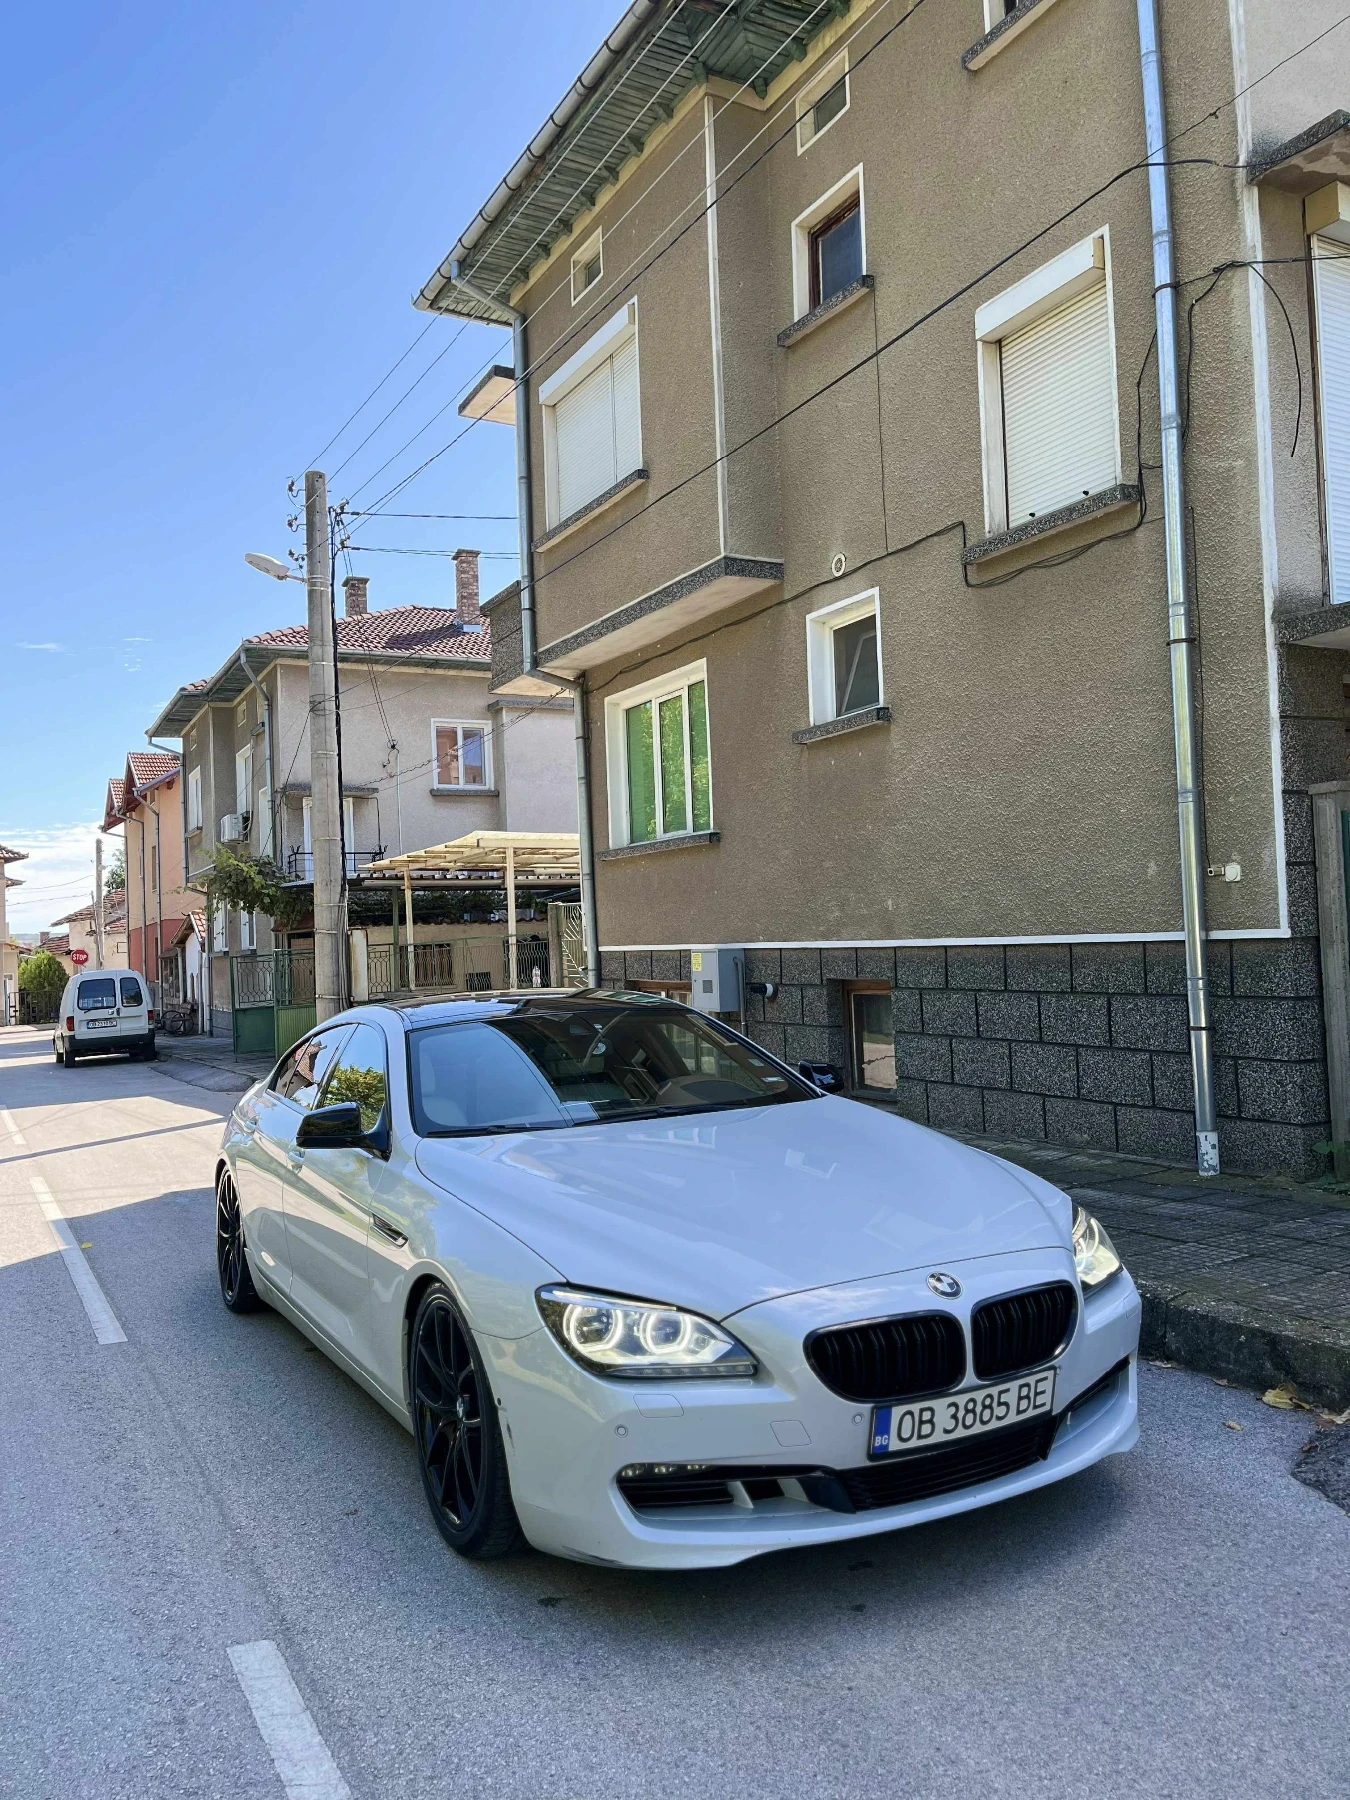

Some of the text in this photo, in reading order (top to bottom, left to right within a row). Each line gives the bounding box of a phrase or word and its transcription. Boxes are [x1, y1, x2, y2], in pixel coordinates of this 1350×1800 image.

[897, 1376, 1049, 1443] OB 3885 BE
[874, 1435, 888, 1447] BG
